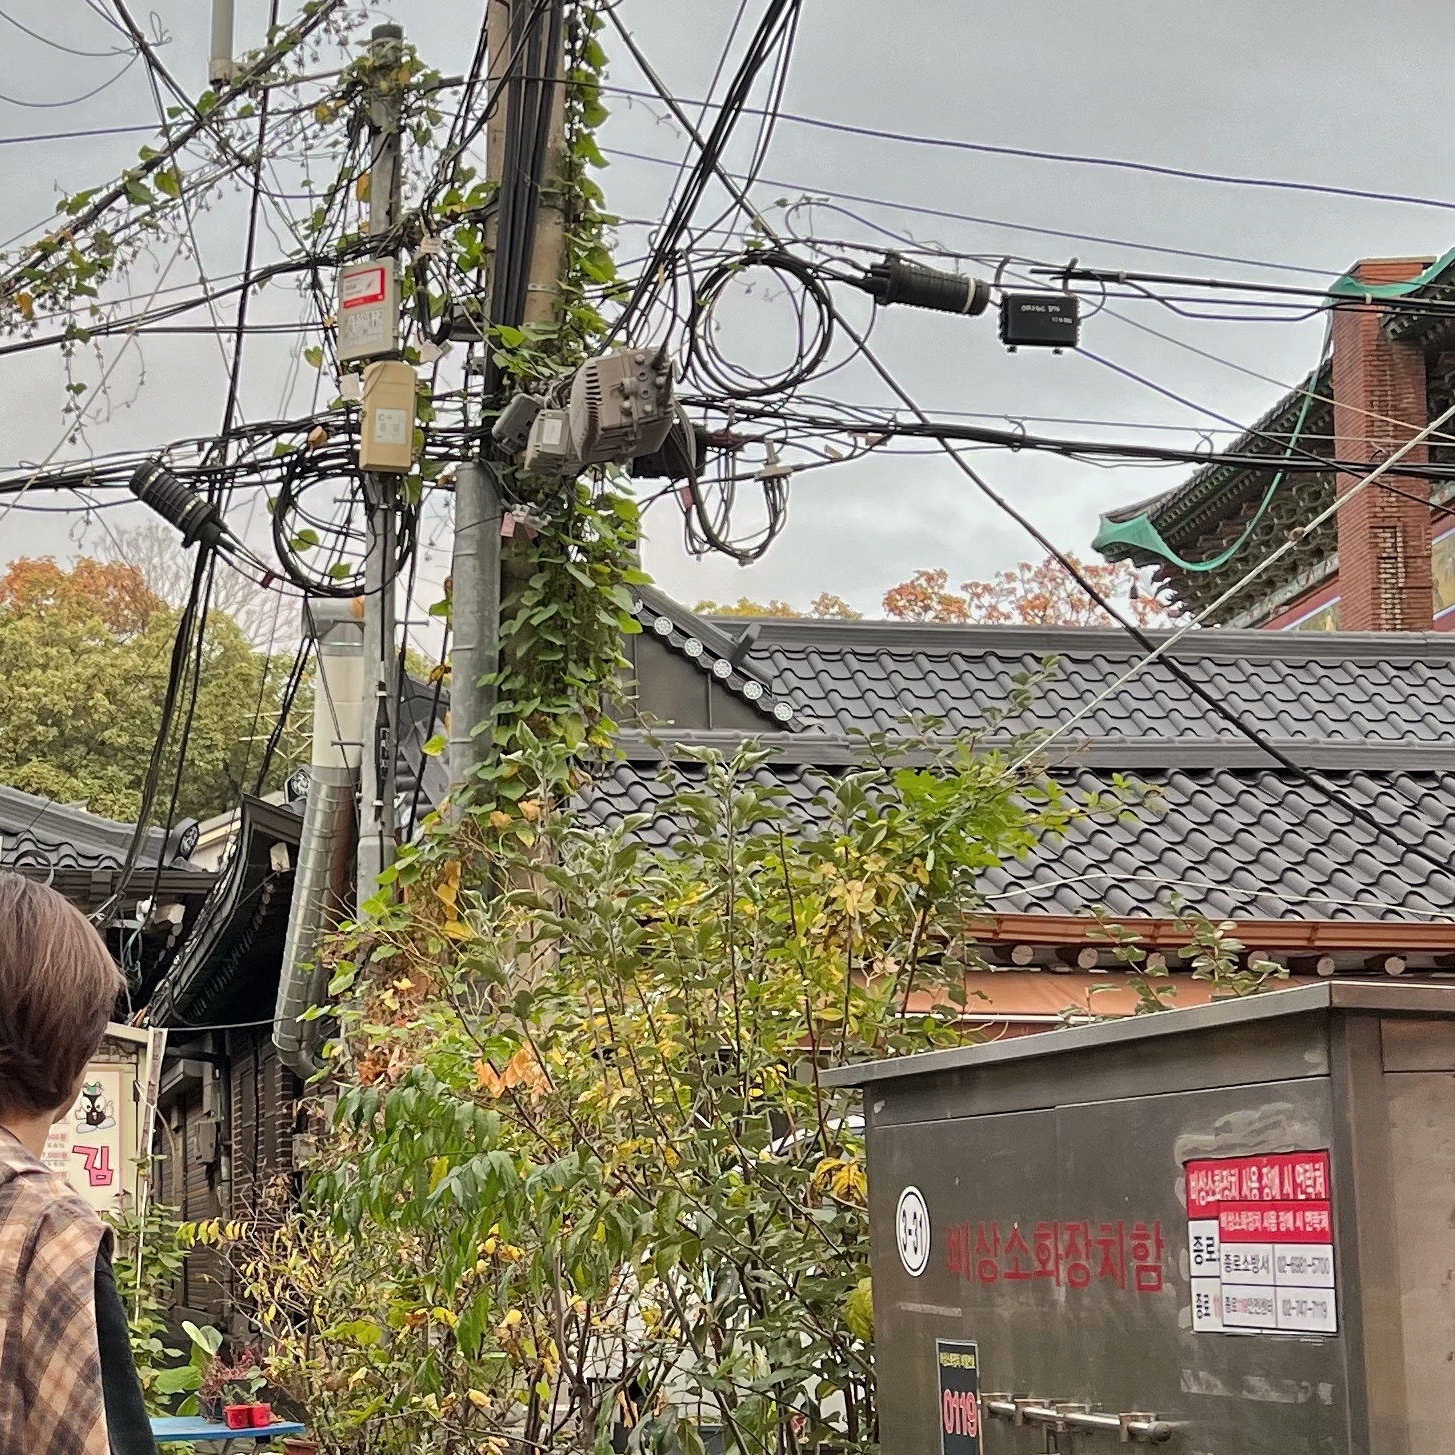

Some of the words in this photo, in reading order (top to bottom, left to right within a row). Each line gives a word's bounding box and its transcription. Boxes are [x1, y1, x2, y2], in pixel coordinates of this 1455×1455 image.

[71, 1144, 114, 1187] 김
[902, 1208, 925, 1257] 3-31
[1225, 1253, 1270, 1275] 종로소방서
[943, 1388, 978, 1438] 0119
